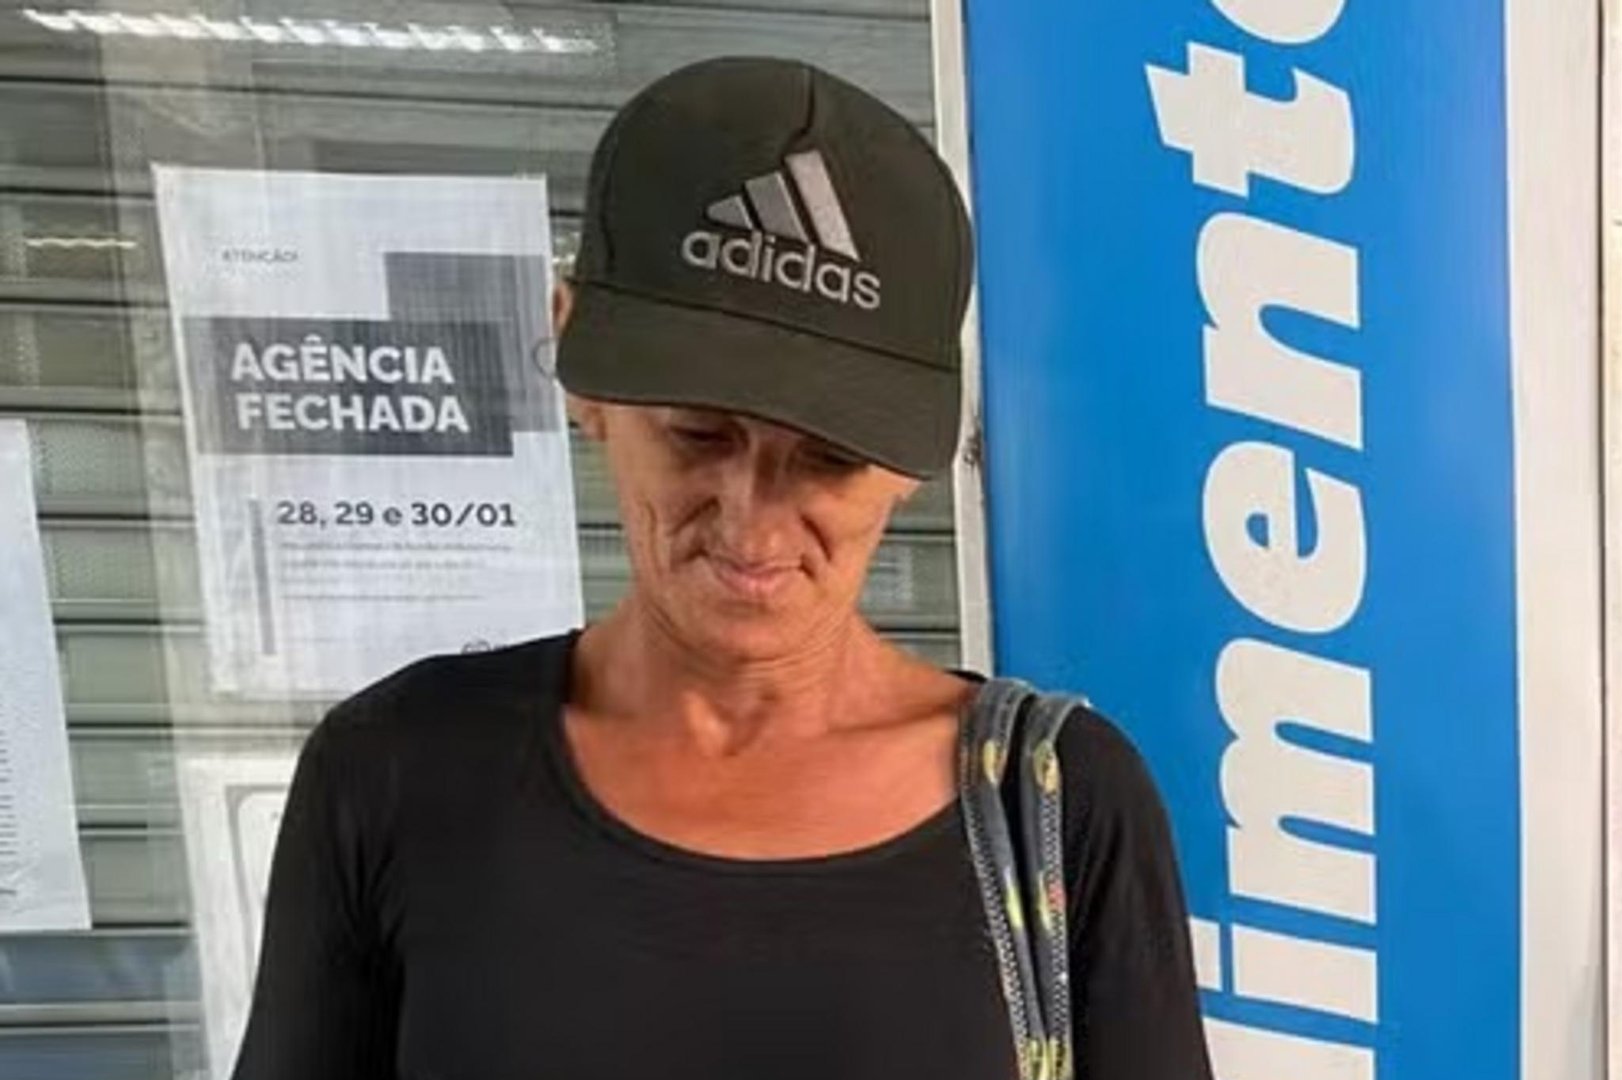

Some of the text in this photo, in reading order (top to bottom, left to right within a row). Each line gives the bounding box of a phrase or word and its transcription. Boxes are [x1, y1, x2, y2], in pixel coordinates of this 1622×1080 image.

[681, 230, 881, 310] adidas
[230, 334, 456, 385] AGÊNCIA
[236, 392, 470, 434] FECHADA
[277, 501, 517, 530] 28, 29 e 30/01
